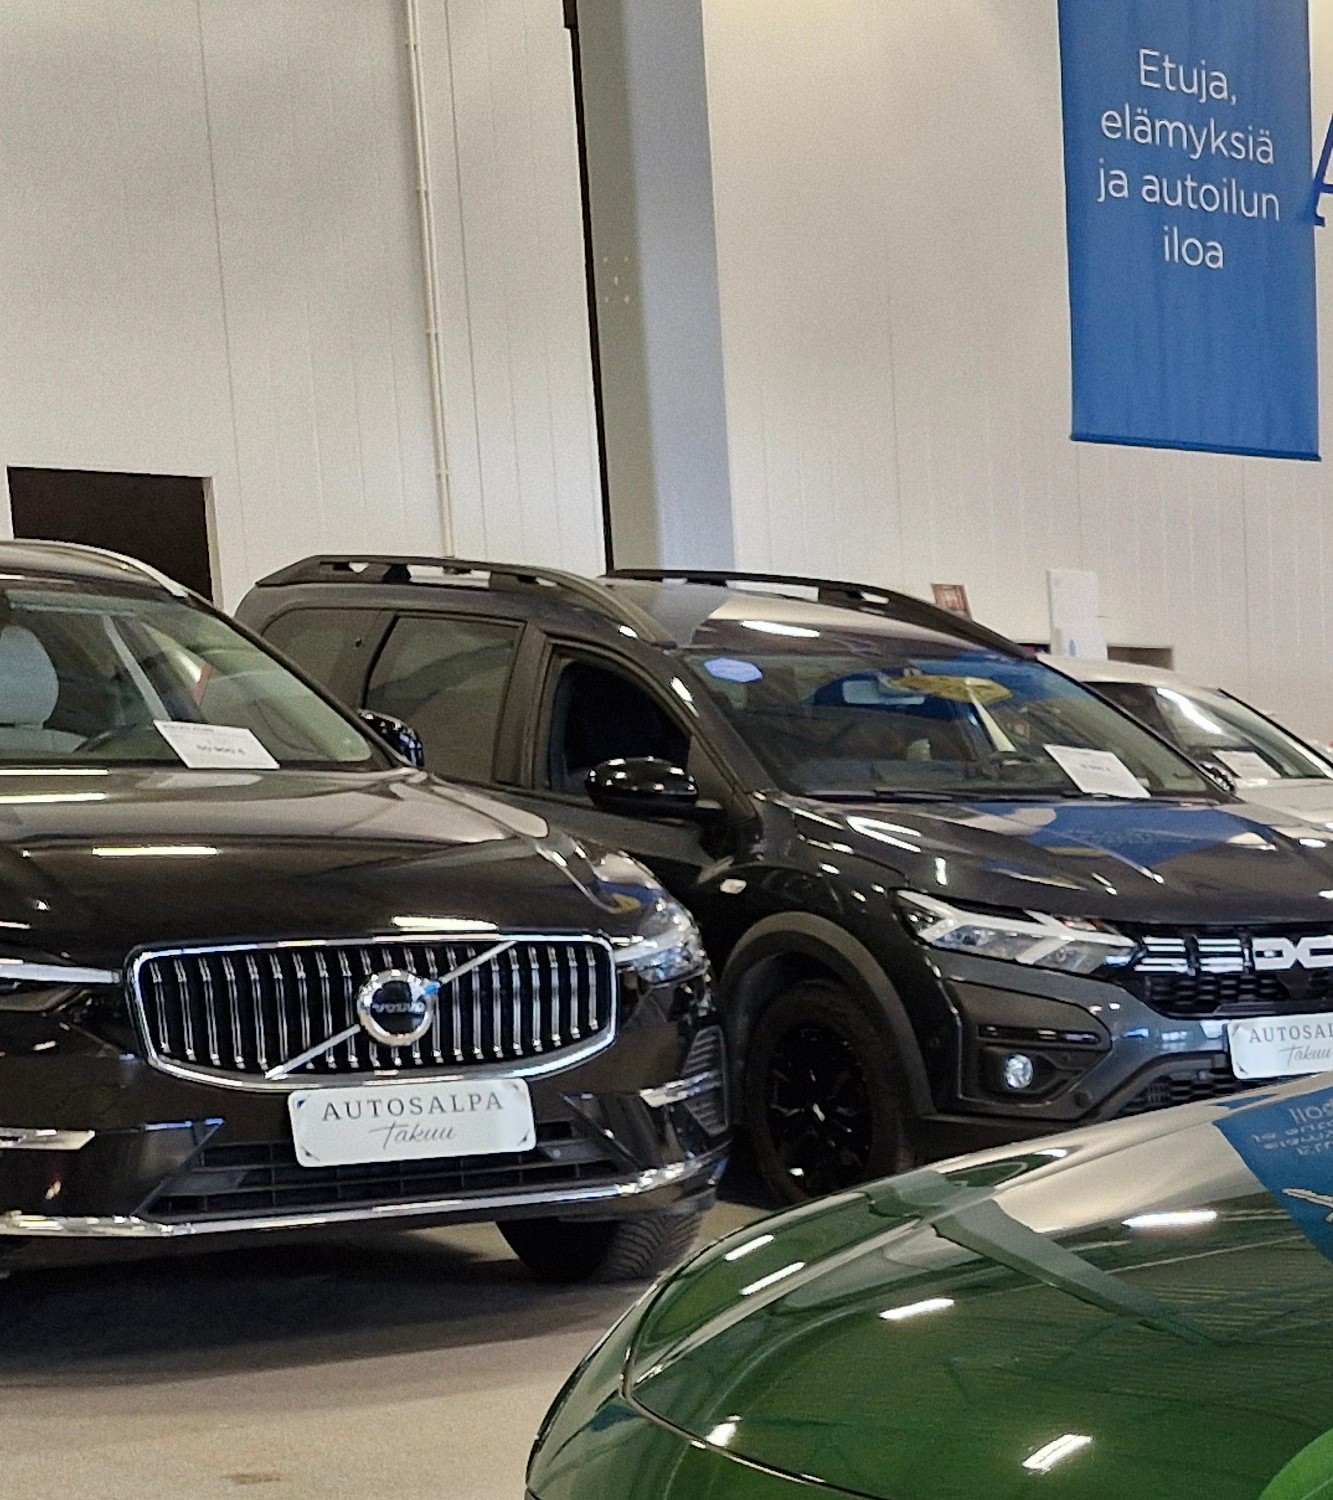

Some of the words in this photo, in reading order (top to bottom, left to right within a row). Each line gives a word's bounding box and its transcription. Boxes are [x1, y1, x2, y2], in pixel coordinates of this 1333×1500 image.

[1139, 49, 1237, 105] Etuja,
[1101, 103, 1274, 164] elämyksiä
[1097, 158, 1130, 203] ja
[1141, 173, 1280, 221] autoilun
[1163, 225, 1224, 269] iloa
[1278, 1043, 1333, 1067] Takuu
[322, 1091, 505, 1122] AUTOSALPA
[369, 1122, 454, 1150] Takuu
